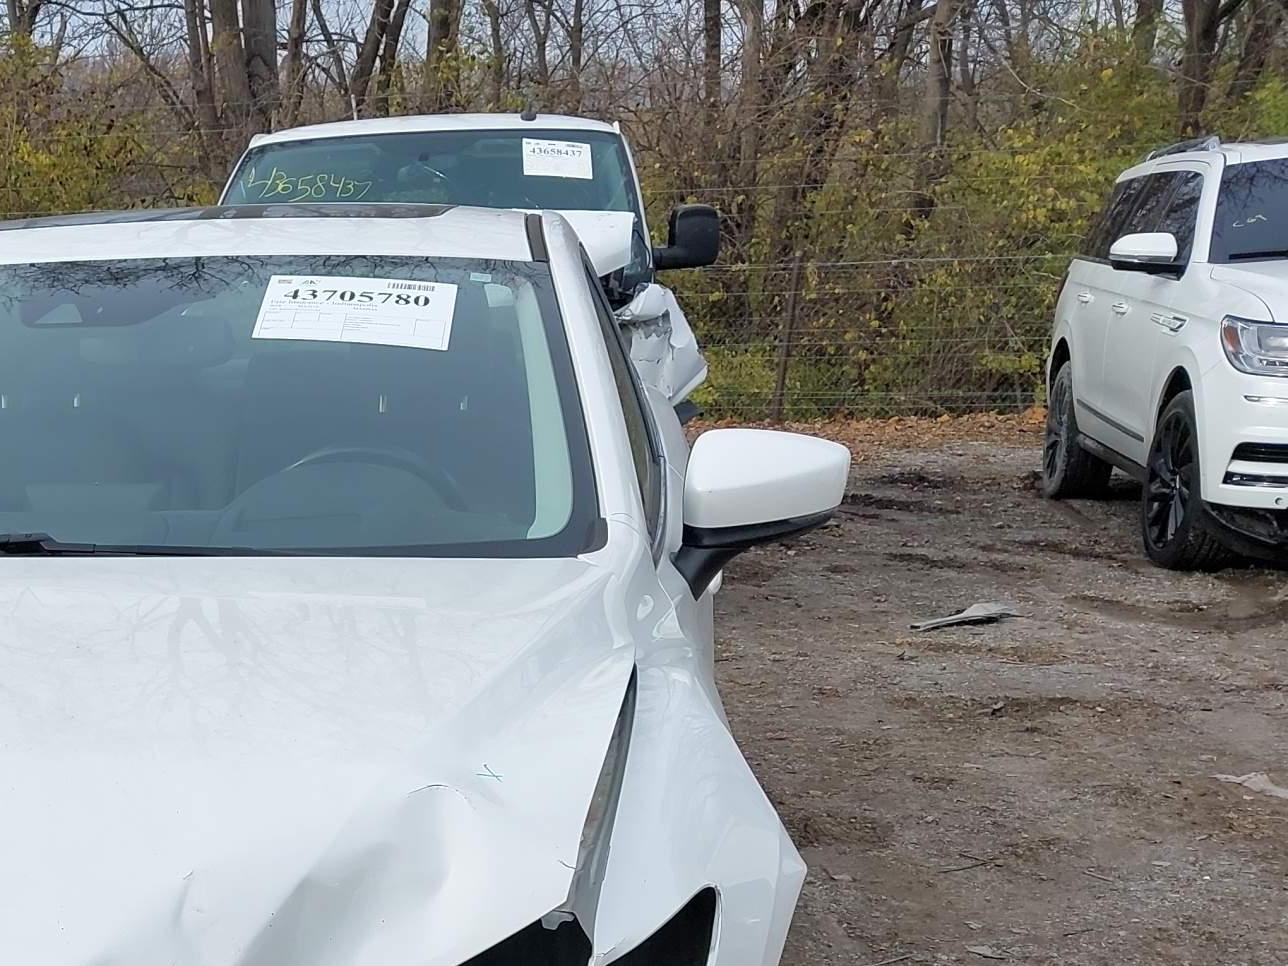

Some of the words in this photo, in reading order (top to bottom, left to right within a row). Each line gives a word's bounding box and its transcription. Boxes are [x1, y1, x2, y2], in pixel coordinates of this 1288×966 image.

[529, 147, 583, 158] 43658437
[247, 167, 373, 202] 43658437
[283, 288, 431, 308] 43705780
